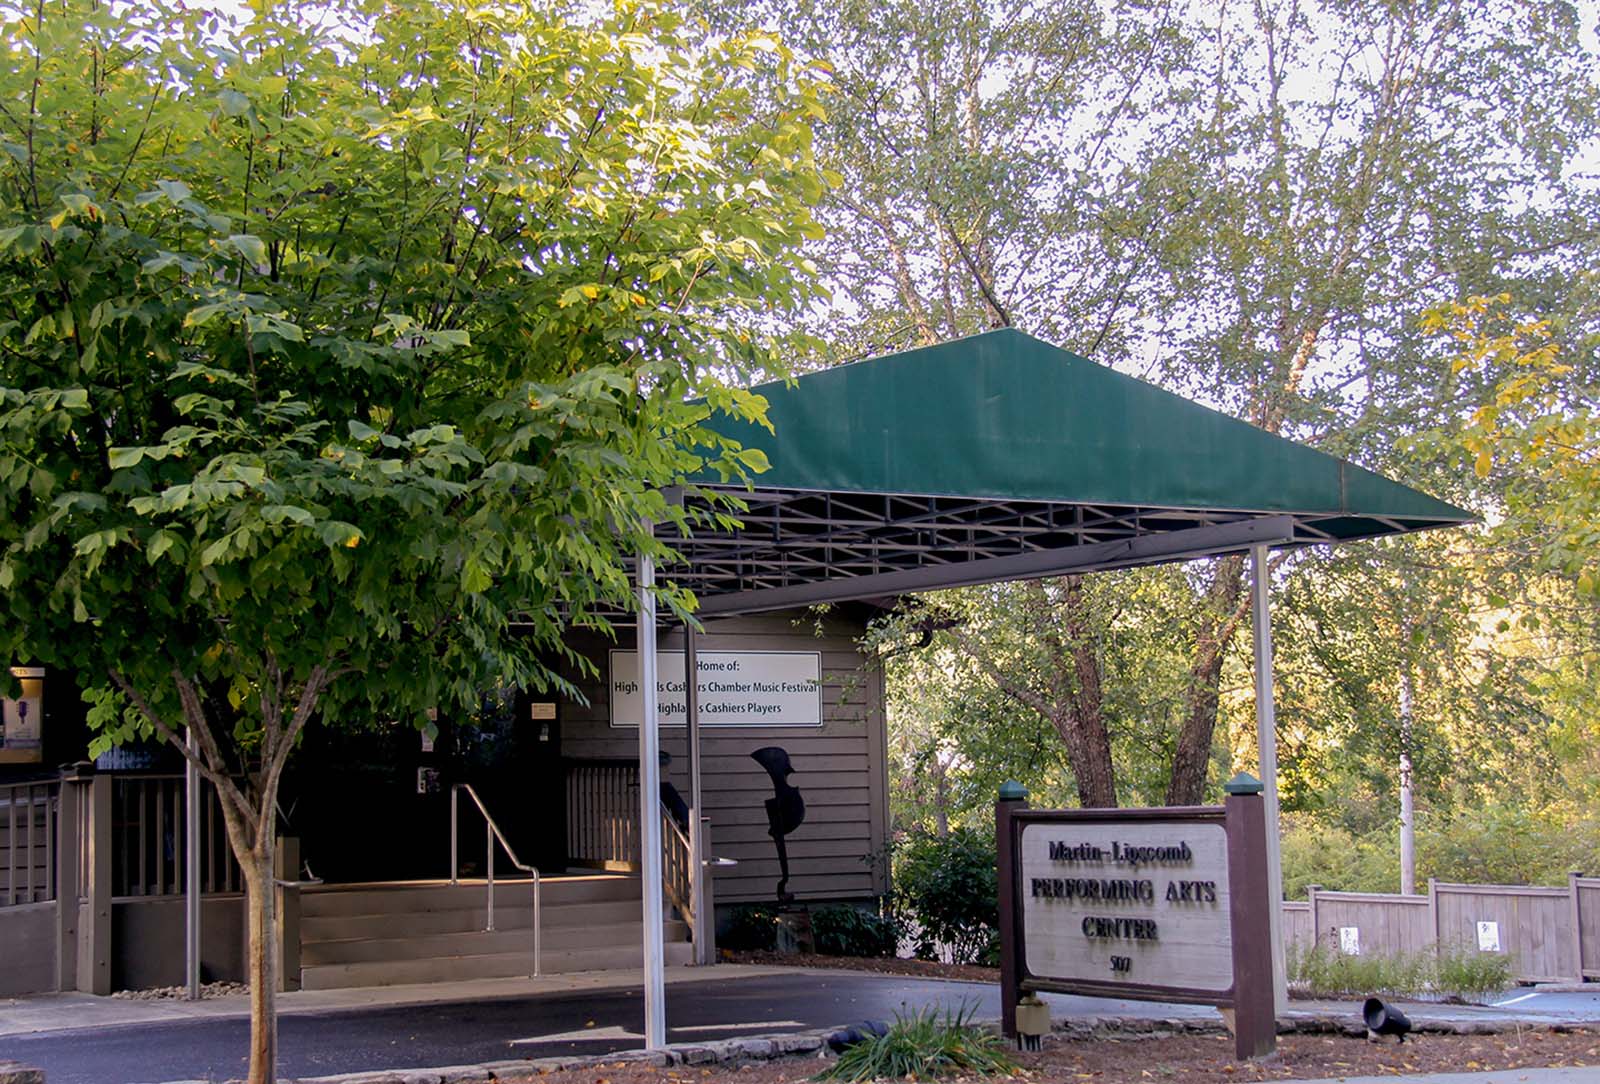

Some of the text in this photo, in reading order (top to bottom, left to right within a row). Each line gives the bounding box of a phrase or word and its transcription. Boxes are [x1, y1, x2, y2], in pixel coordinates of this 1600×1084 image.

[696, 660, 740, 672] Home of:
[666, 681, 706, 693] Cashrs
[708, 681, 751, 693] Chamber
[753, 682, 780, 693] Music
[781, 682, 817, 693] Festival
[705, 702, 746, 713] Cashiers
[747, 702, 782, 716] Players
[1048, 840, 1192, 866] Martin-Lipscomb
[1031, 878, 1217, 902] PERFORMING ARTS
[1081, 916, 1159, 940] CENTER
[1110, 955, 1132, 973] 507
